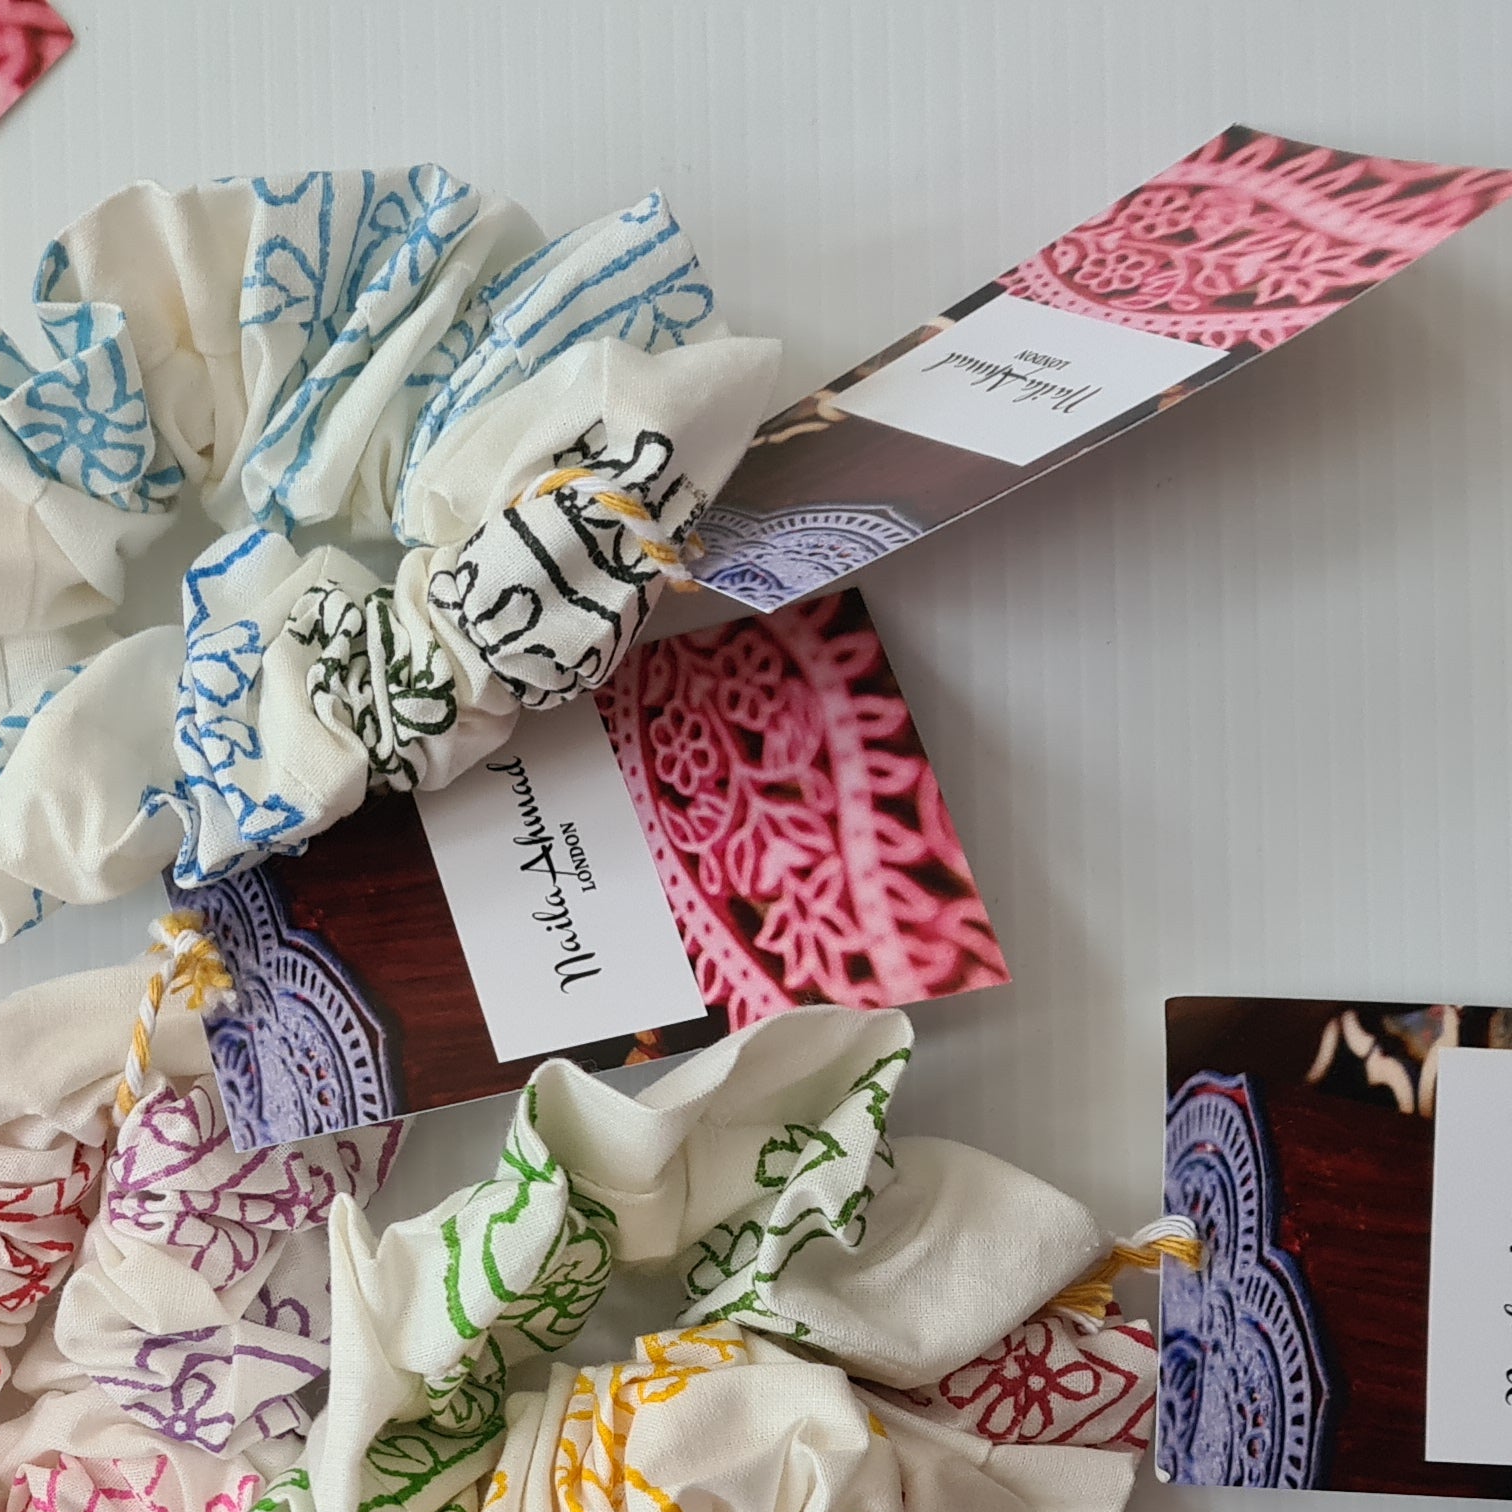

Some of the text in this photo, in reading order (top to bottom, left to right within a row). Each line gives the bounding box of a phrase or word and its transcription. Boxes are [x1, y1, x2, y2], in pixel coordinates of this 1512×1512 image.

[486, 755, 602, 994] Naila Ahmad
[559, 822, 597, 893] LONDON
